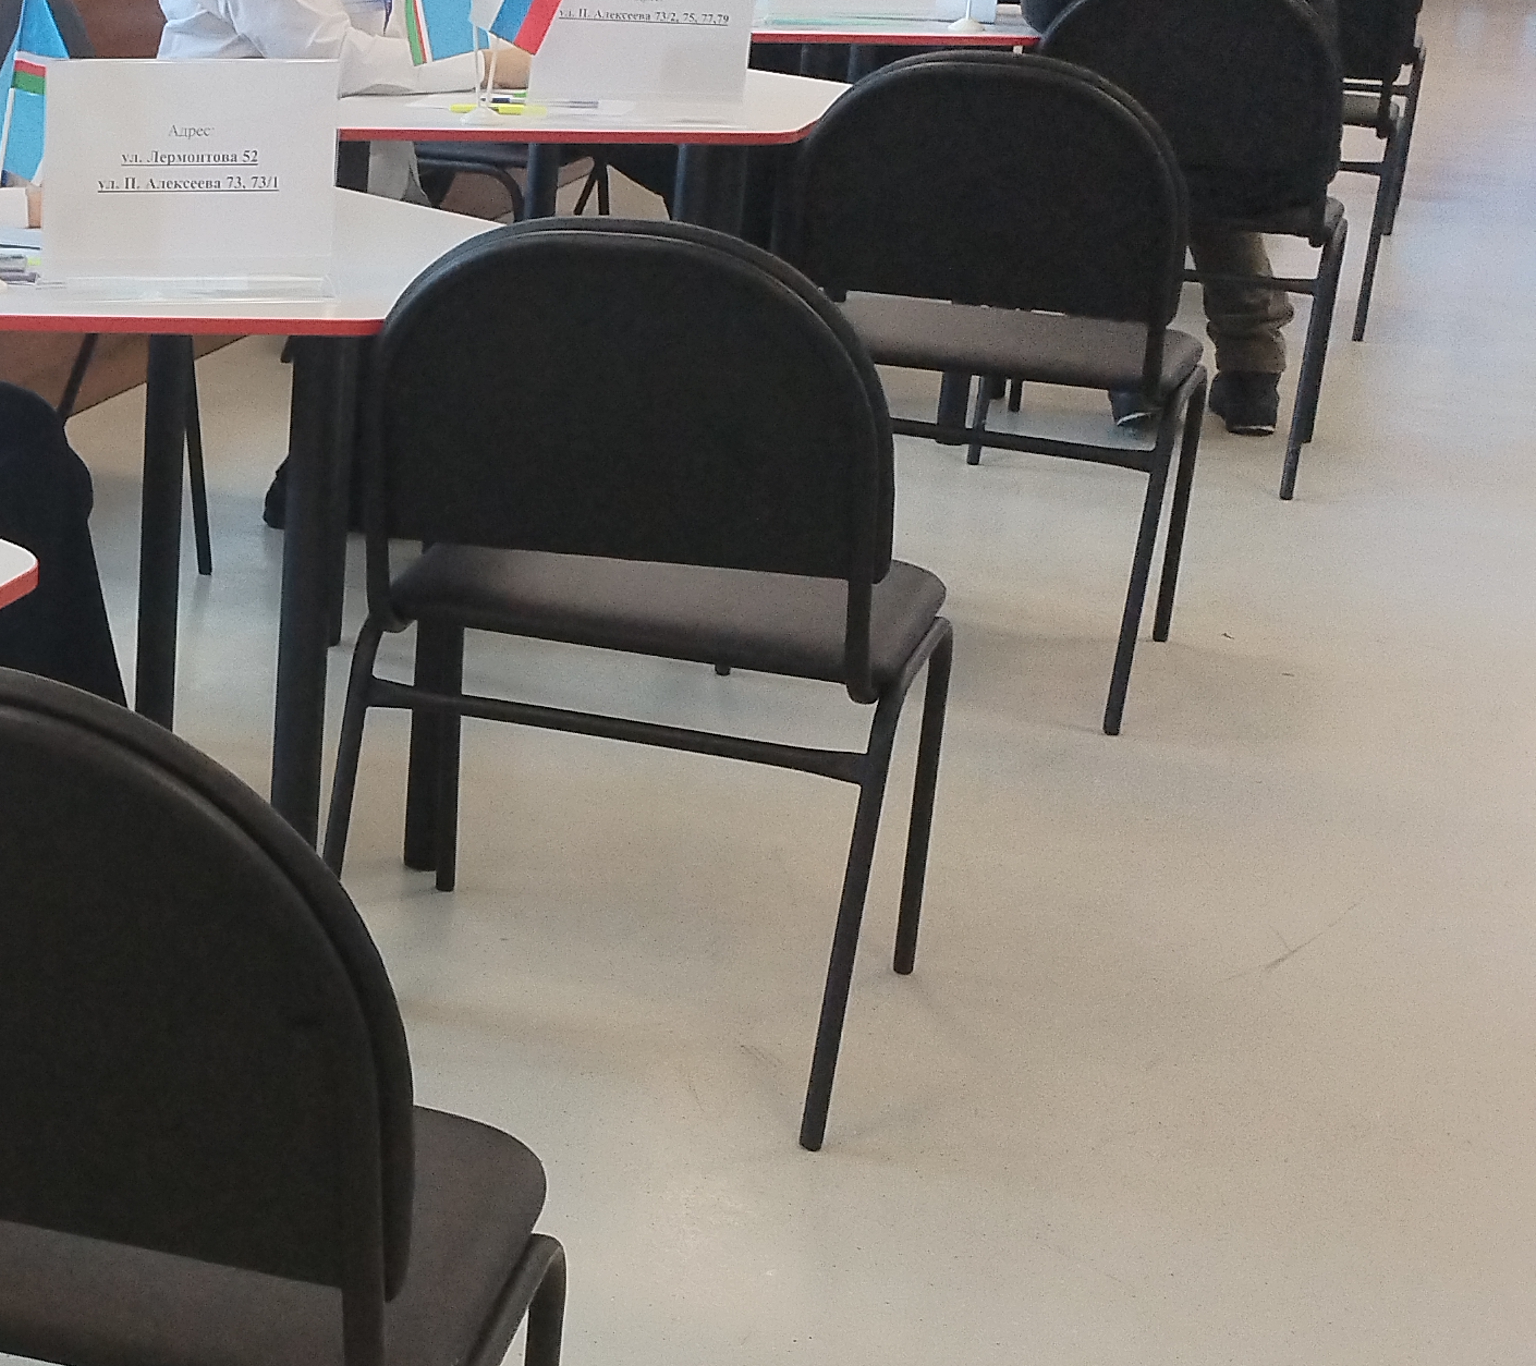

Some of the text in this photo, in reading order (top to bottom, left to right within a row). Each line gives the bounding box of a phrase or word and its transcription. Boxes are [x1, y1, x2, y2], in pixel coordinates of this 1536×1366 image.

[595, 9, 651, 20] Алексеева
[654, 11, 680, 23] 73/2,
[683, 12, 698, 24] 75,
[121, 149, 259, 165] ул. Лермонтова 52
[97, 175, 279, 191] ул. П. Алексеева 73, 73/1
